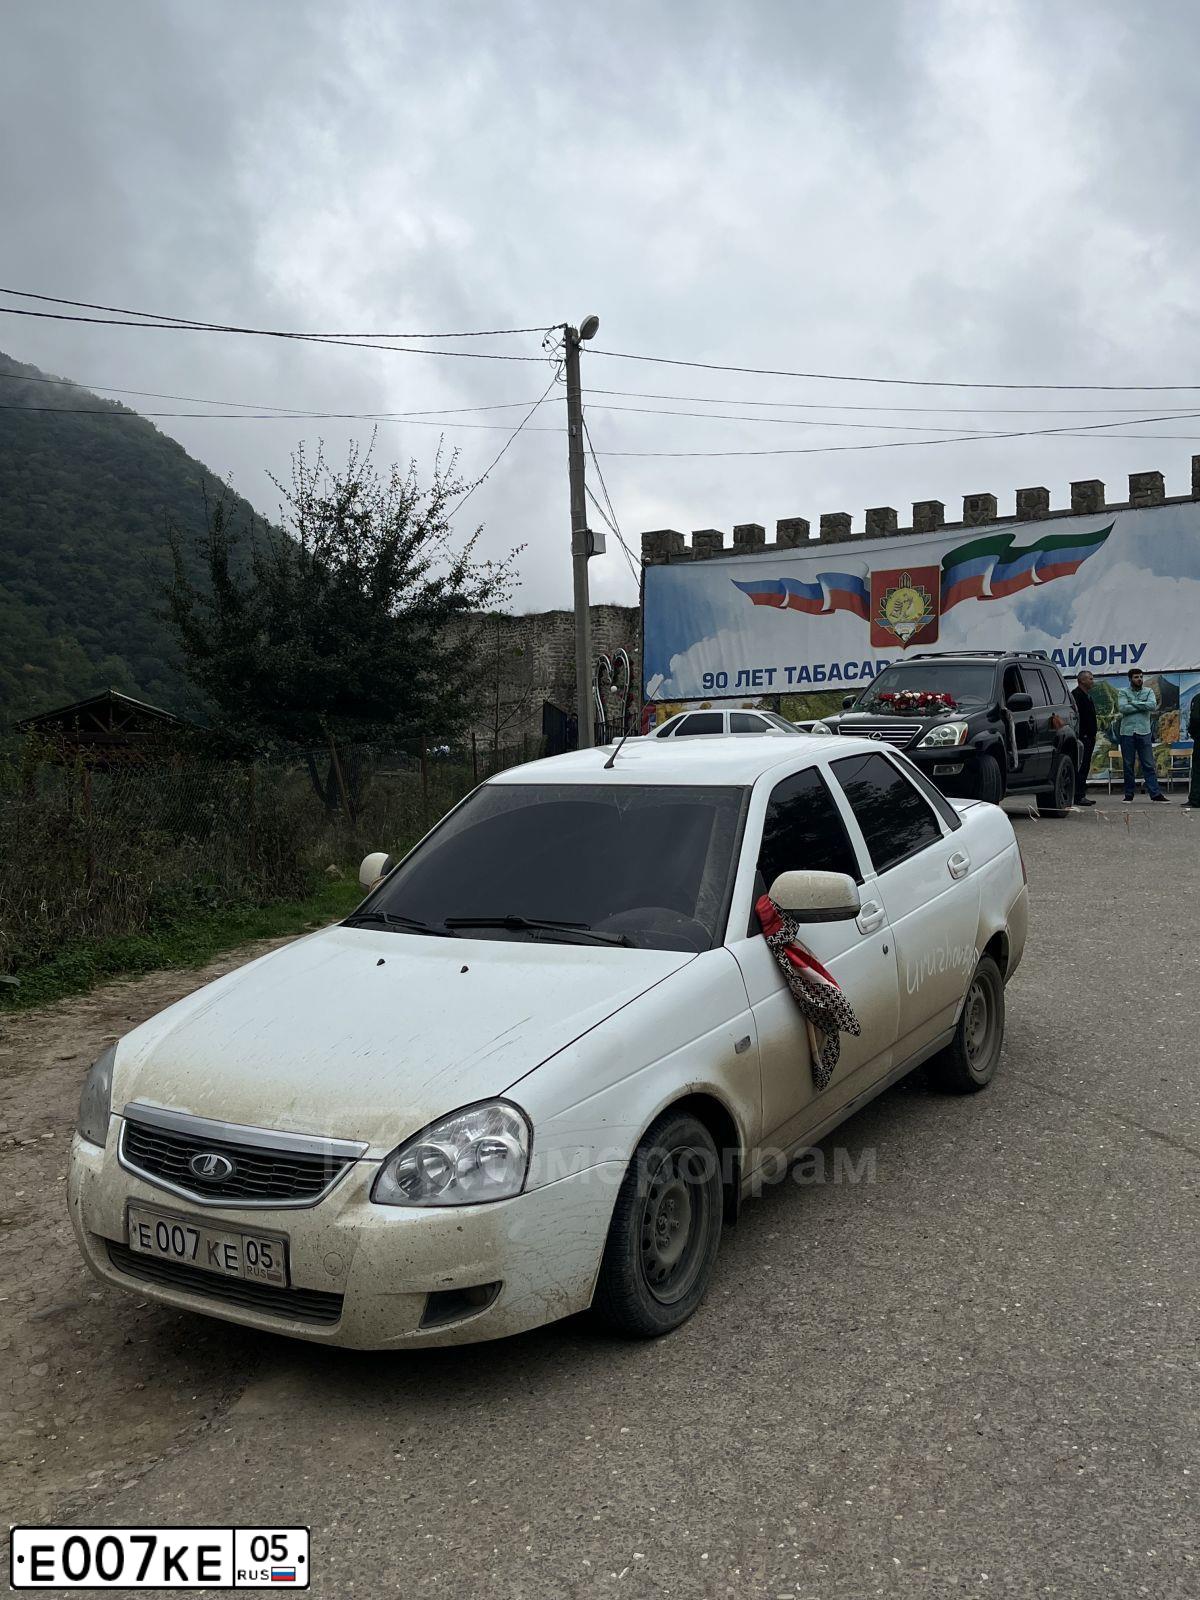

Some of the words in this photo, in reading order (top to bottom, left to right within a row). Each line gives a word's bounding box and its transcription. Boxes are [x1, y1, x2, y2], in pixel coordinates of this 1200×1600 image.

[702, 671, 729, 690] 90
[735, 668, 778, 688] ЛЕТ
[1030, 642, 1148, 668] АЙОНУ
[246, 1240, 273, 1268] 05
[246, 1266, 267, 1279] RUS
